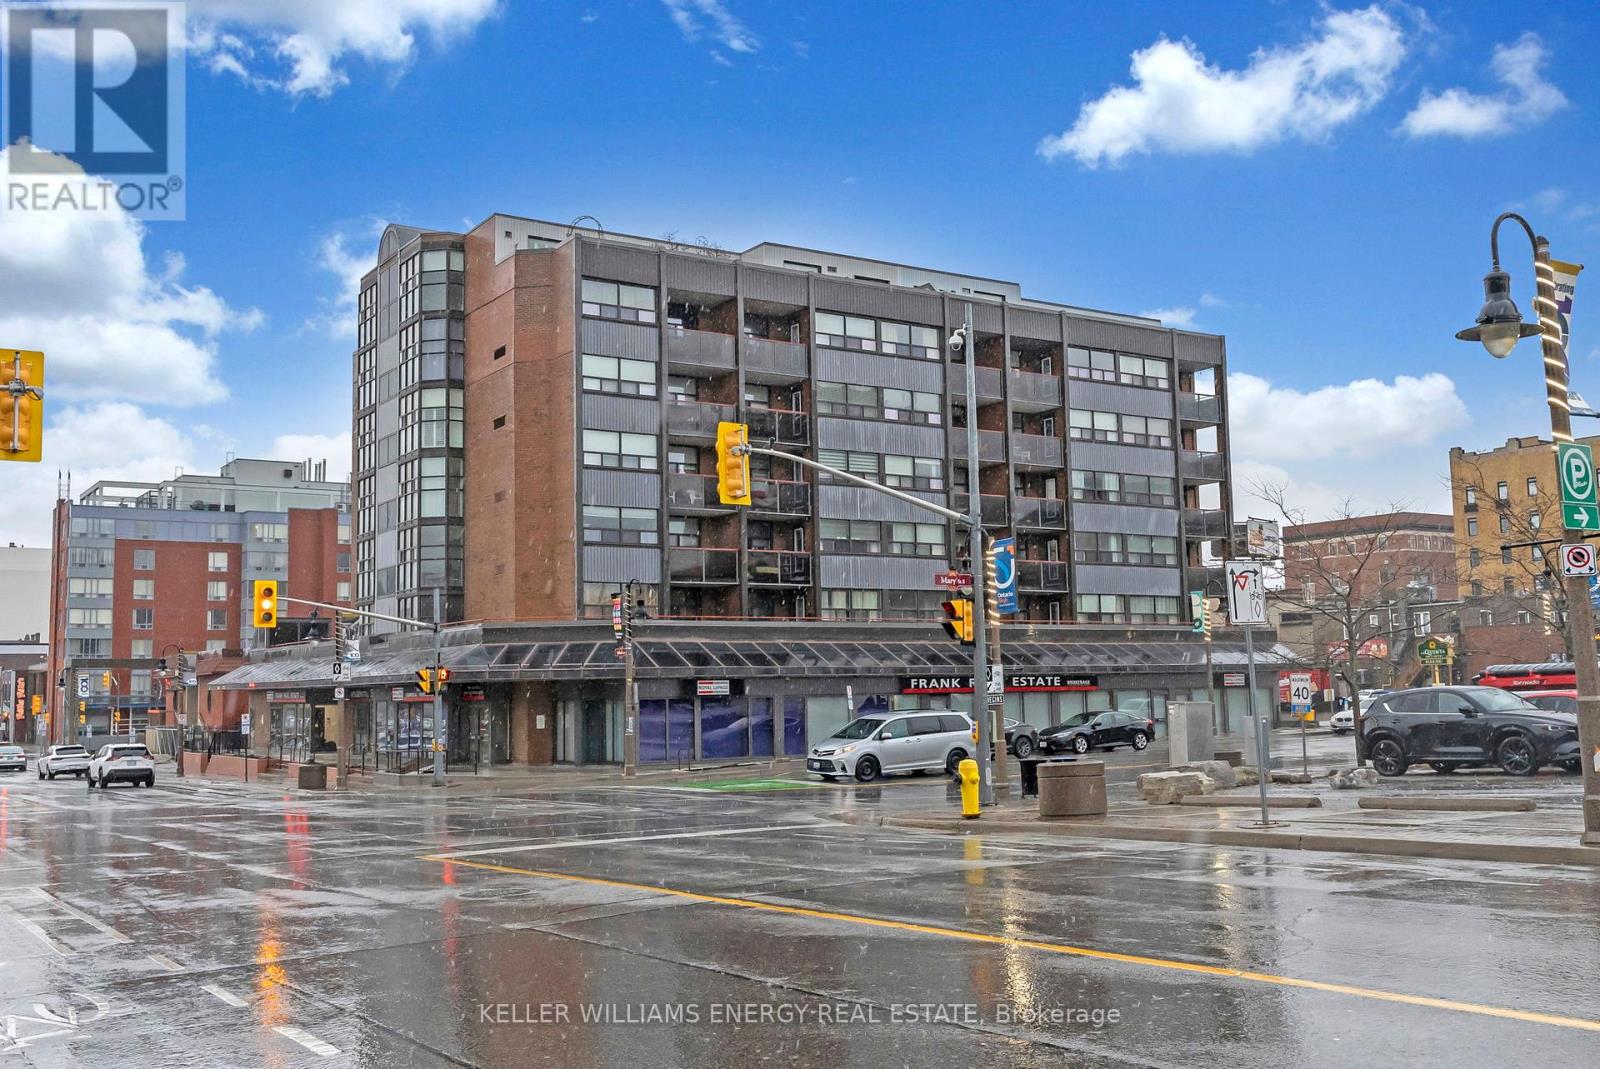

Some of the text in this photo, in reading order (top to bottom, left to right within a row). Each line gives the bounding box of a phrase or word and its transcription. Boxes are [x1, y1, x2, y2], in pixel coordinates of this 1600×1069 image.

[940, 576, 957, 585] Mary
[910, 678, 961, 689] FRANK
[1012, 676, 1061, 687] ESTATE
[1293, 686, 1309, 700] 40
